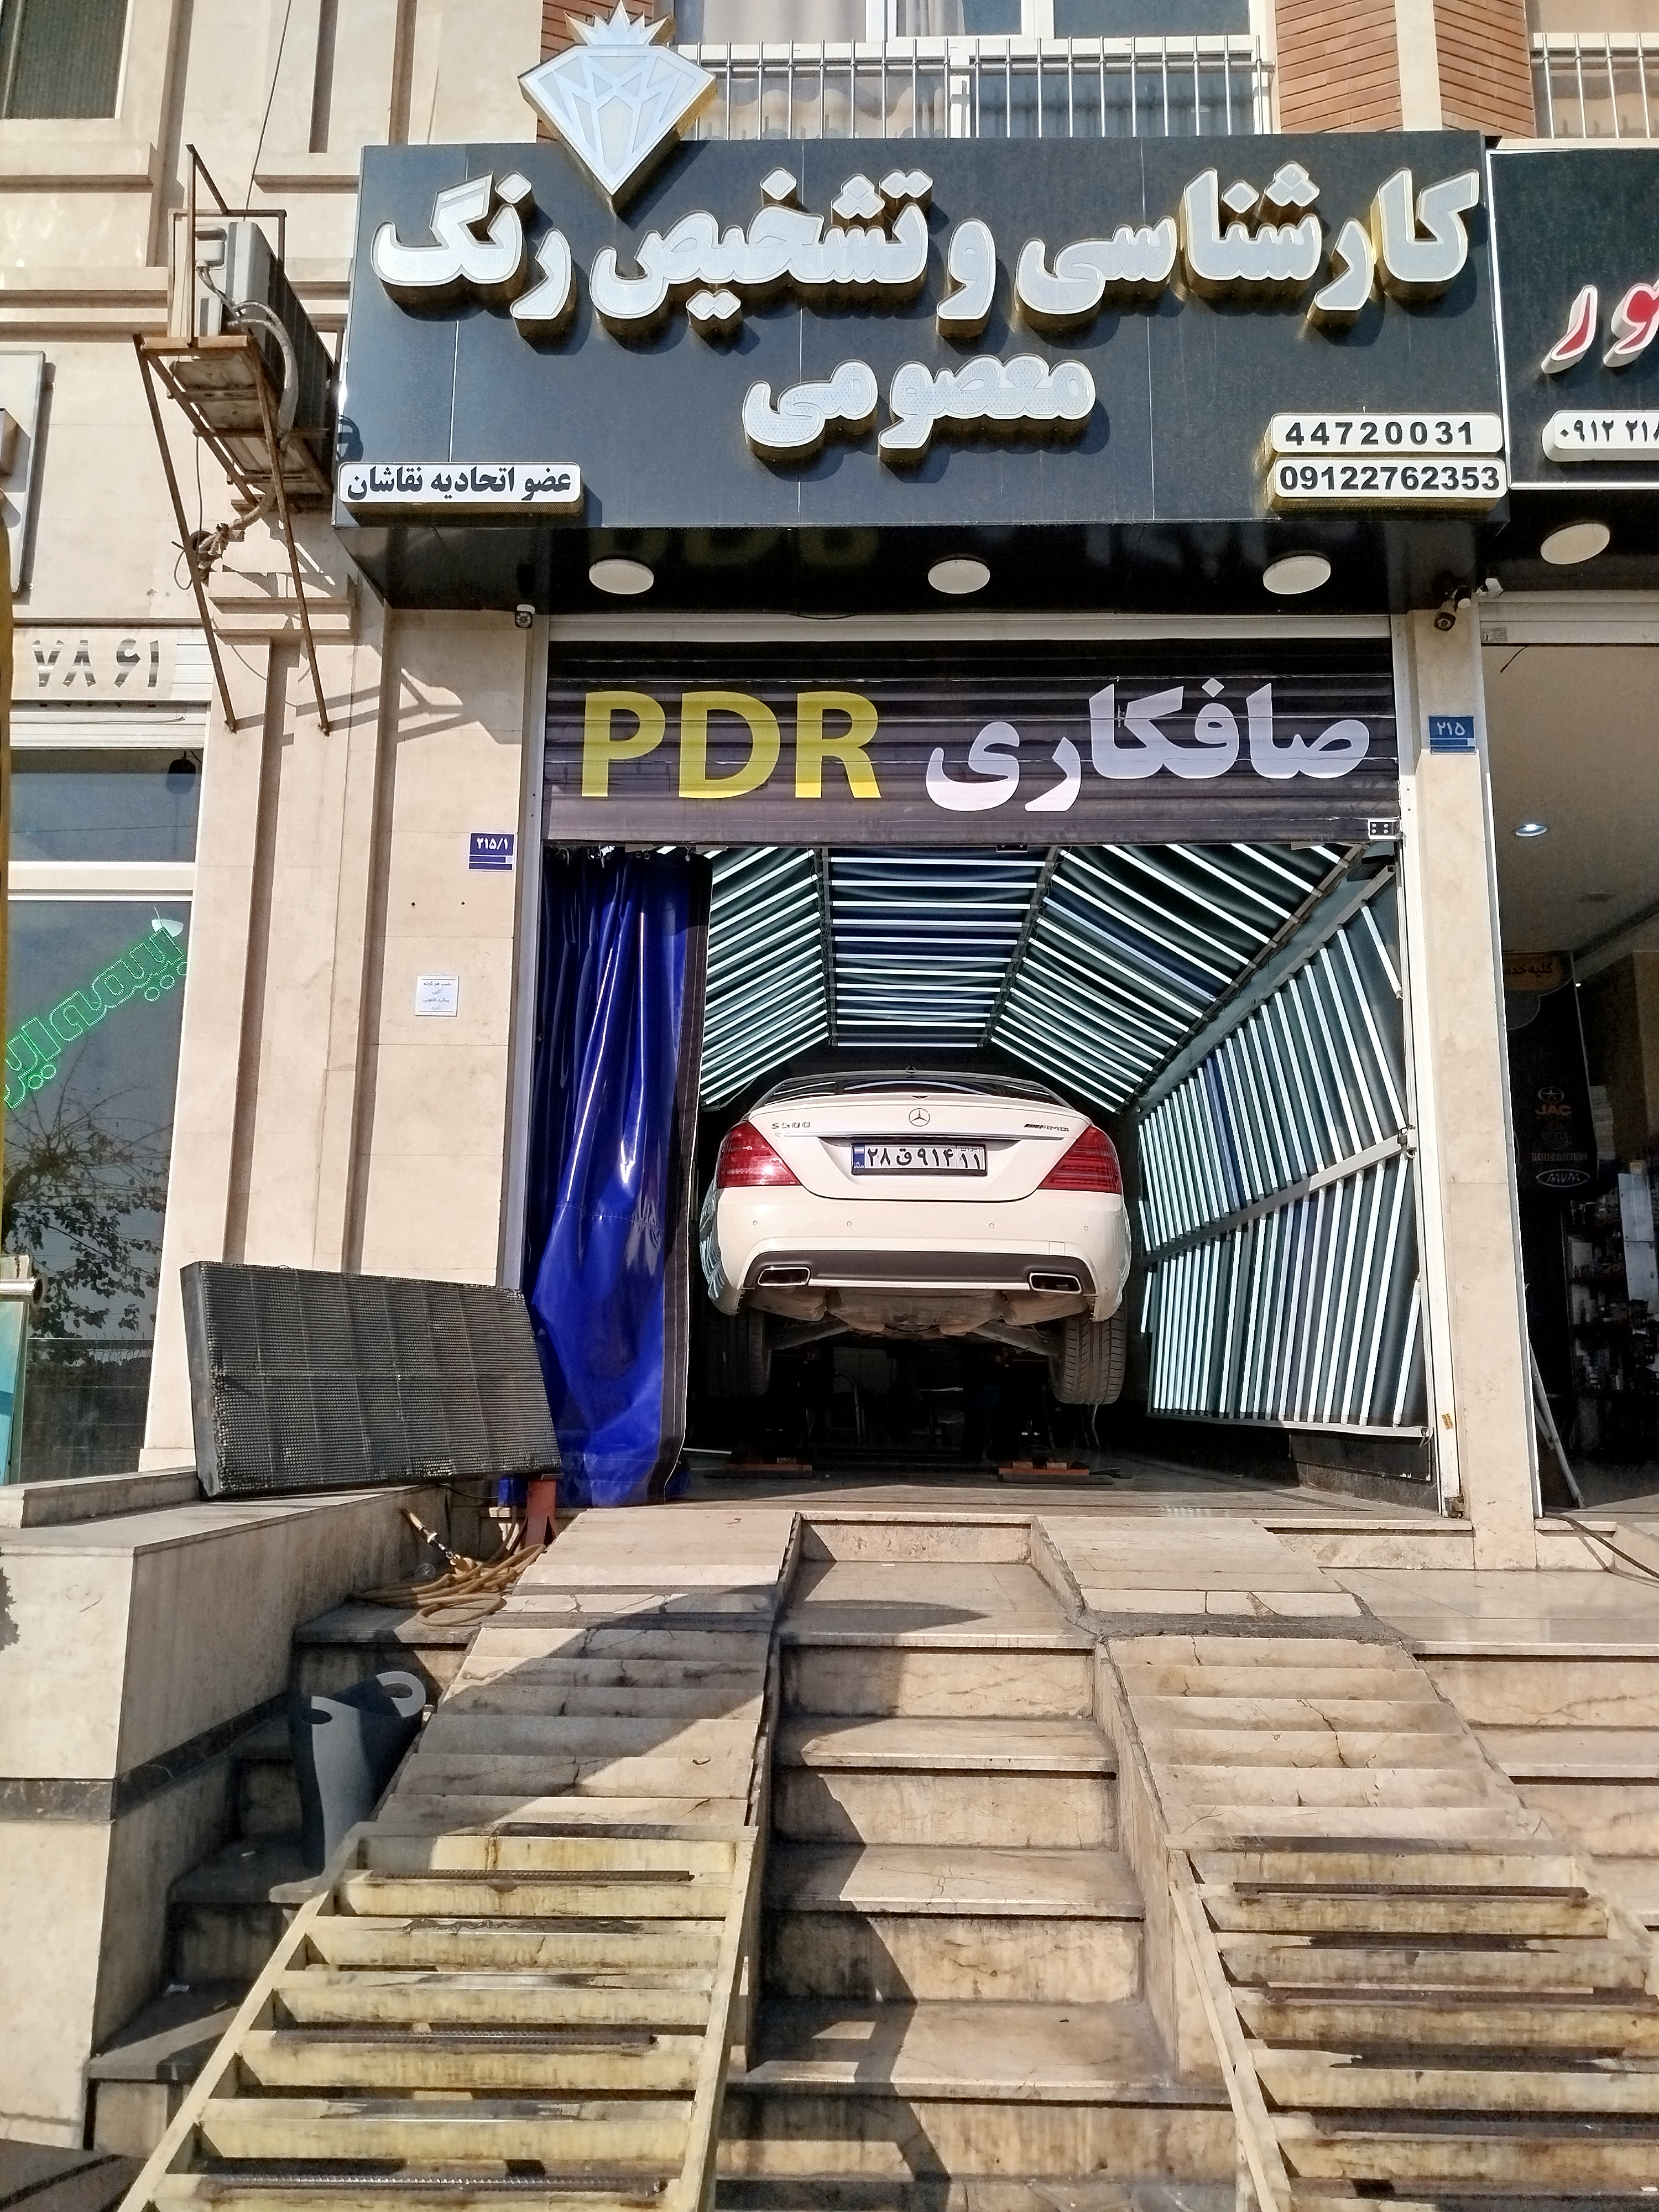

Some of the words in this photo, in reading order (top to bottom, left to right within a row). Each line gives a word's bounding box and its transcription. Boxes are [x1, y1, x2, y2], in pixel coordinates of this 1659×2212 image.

[371, 170, 572, 320] رنگ
[589, 167, 933, 320] تشخیص
[1015, 160, 1479, 315] کارشناسی
[936, 218, 996, 320] و
[1548, 282, 1659, 366] ور
[742, 354, 1096, 448] معصومی
[1285, 421, 1472, 446] 44720031
[1559, 419, 1614, 442] ۰۹۱۲
[347, 466, 423, 500] نقاشان
[430, 466, 515, 499] اتحادیه
[521, 467, 572, 500] عضو
[1280, 466, 1500, 491] 09122762353
[581, 690, 881, 799] PDR
[925, 677, 1371, 812] صافکاری
[1436, 722, 1465, 736] ۲۱۵
[1503, 965, 1527, 975] خدم
[1535, 1104, 1572, 1116] JAC
